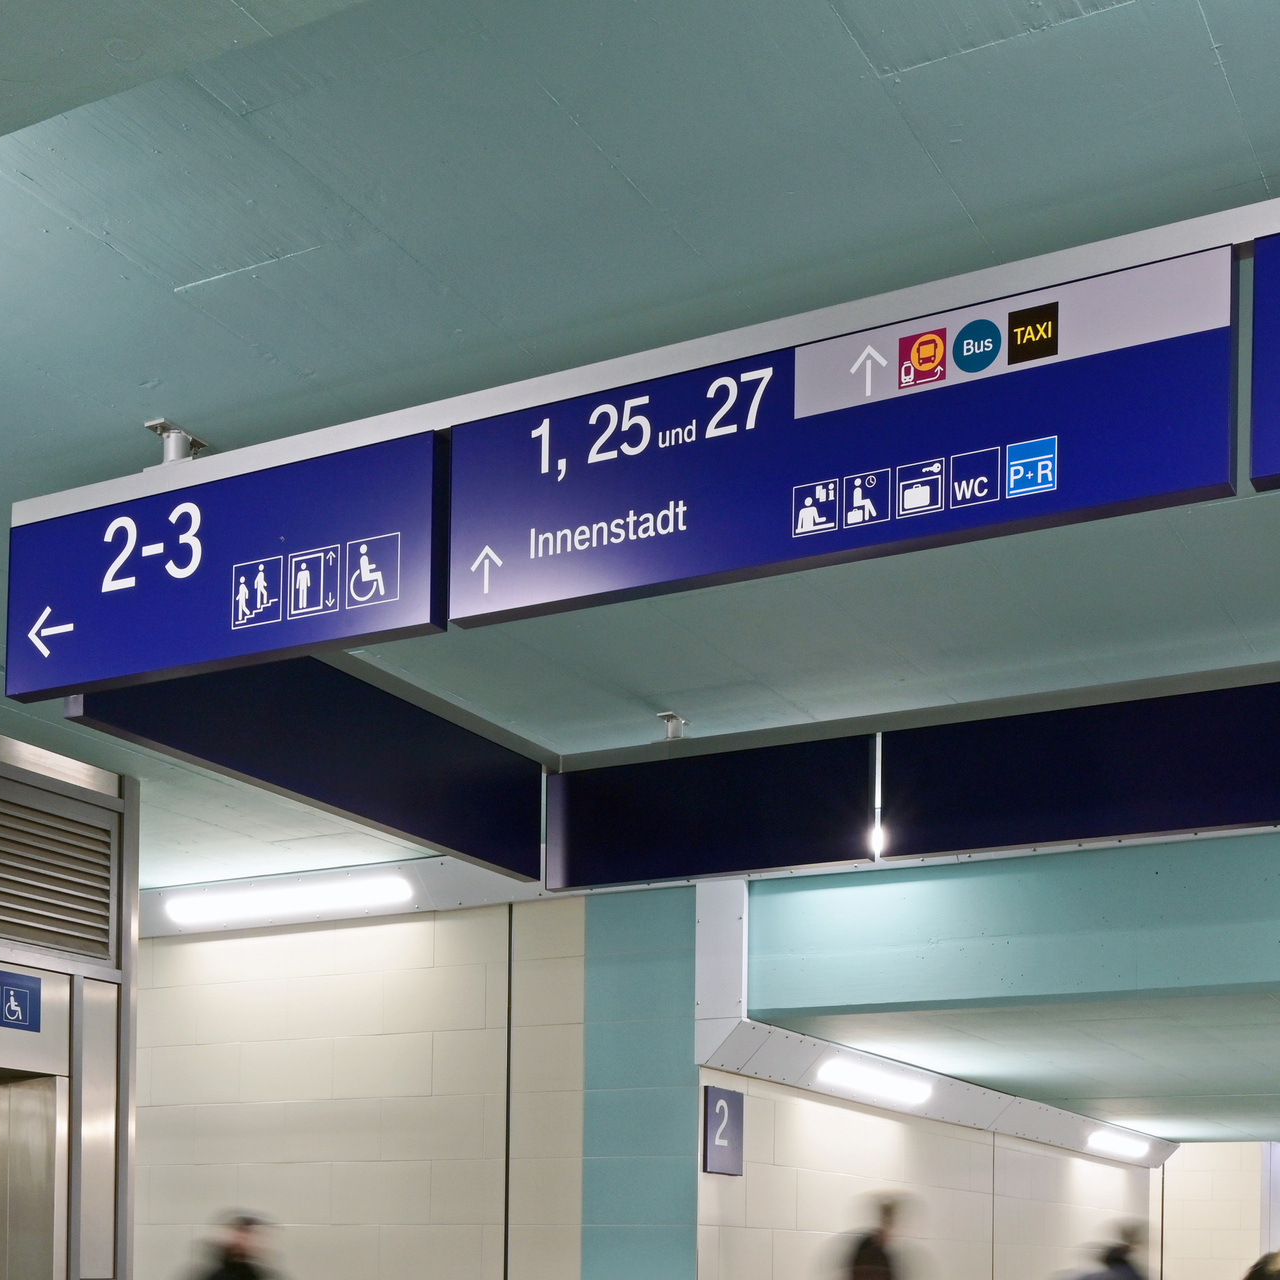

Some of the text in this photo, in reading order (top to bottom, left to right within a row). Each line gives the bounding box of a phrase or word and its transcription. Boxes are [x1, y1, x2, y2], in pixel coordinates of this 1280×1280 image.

[963, 338, 993, 356] Bus
[1014, 321, 1052, 345] TAXI
[531, 367, 773, 482] 1, 25 und 27
[954, 476, 988, 501] WC
[1010, 460, 1053, 488] P+R
[101, 502, 202, 593] 2-3
[530, 500, 687, 559] Innenstadt
[714, 1099, 729, 1146] 2
